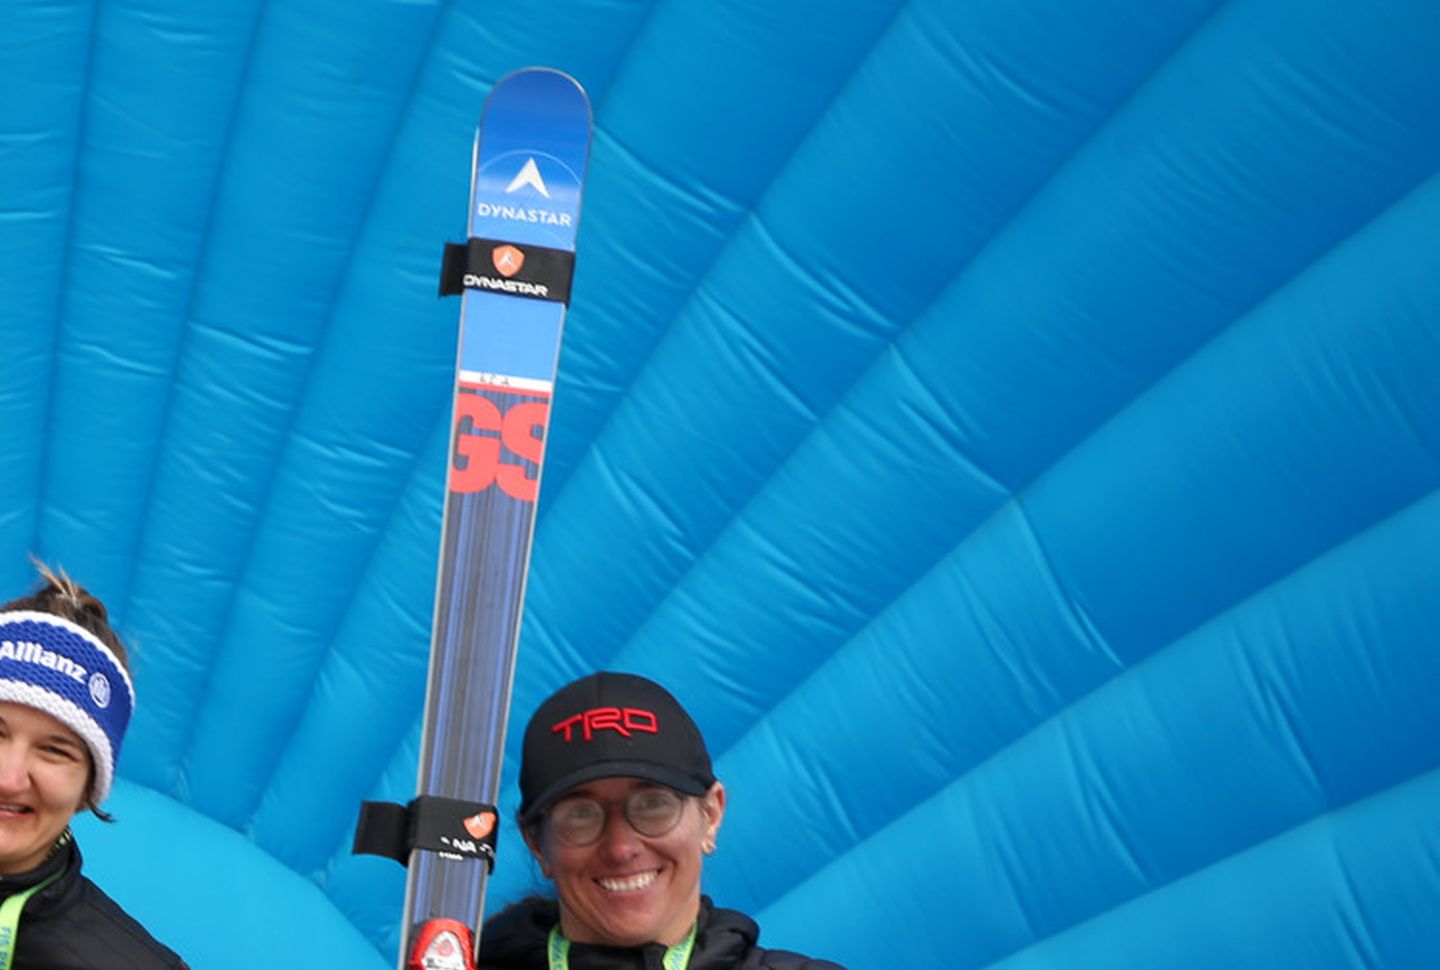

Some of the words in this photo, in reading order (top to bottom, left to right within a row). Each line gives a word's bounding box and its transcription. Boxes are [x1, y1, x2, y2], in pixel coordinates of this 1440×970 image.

[477, 203, 572, 227] DYNASTAR
[463, 274, 548, 297] DYNASTAR
[450, 393, 551, 502] GS
[551, 707, 658, 742] TRD
